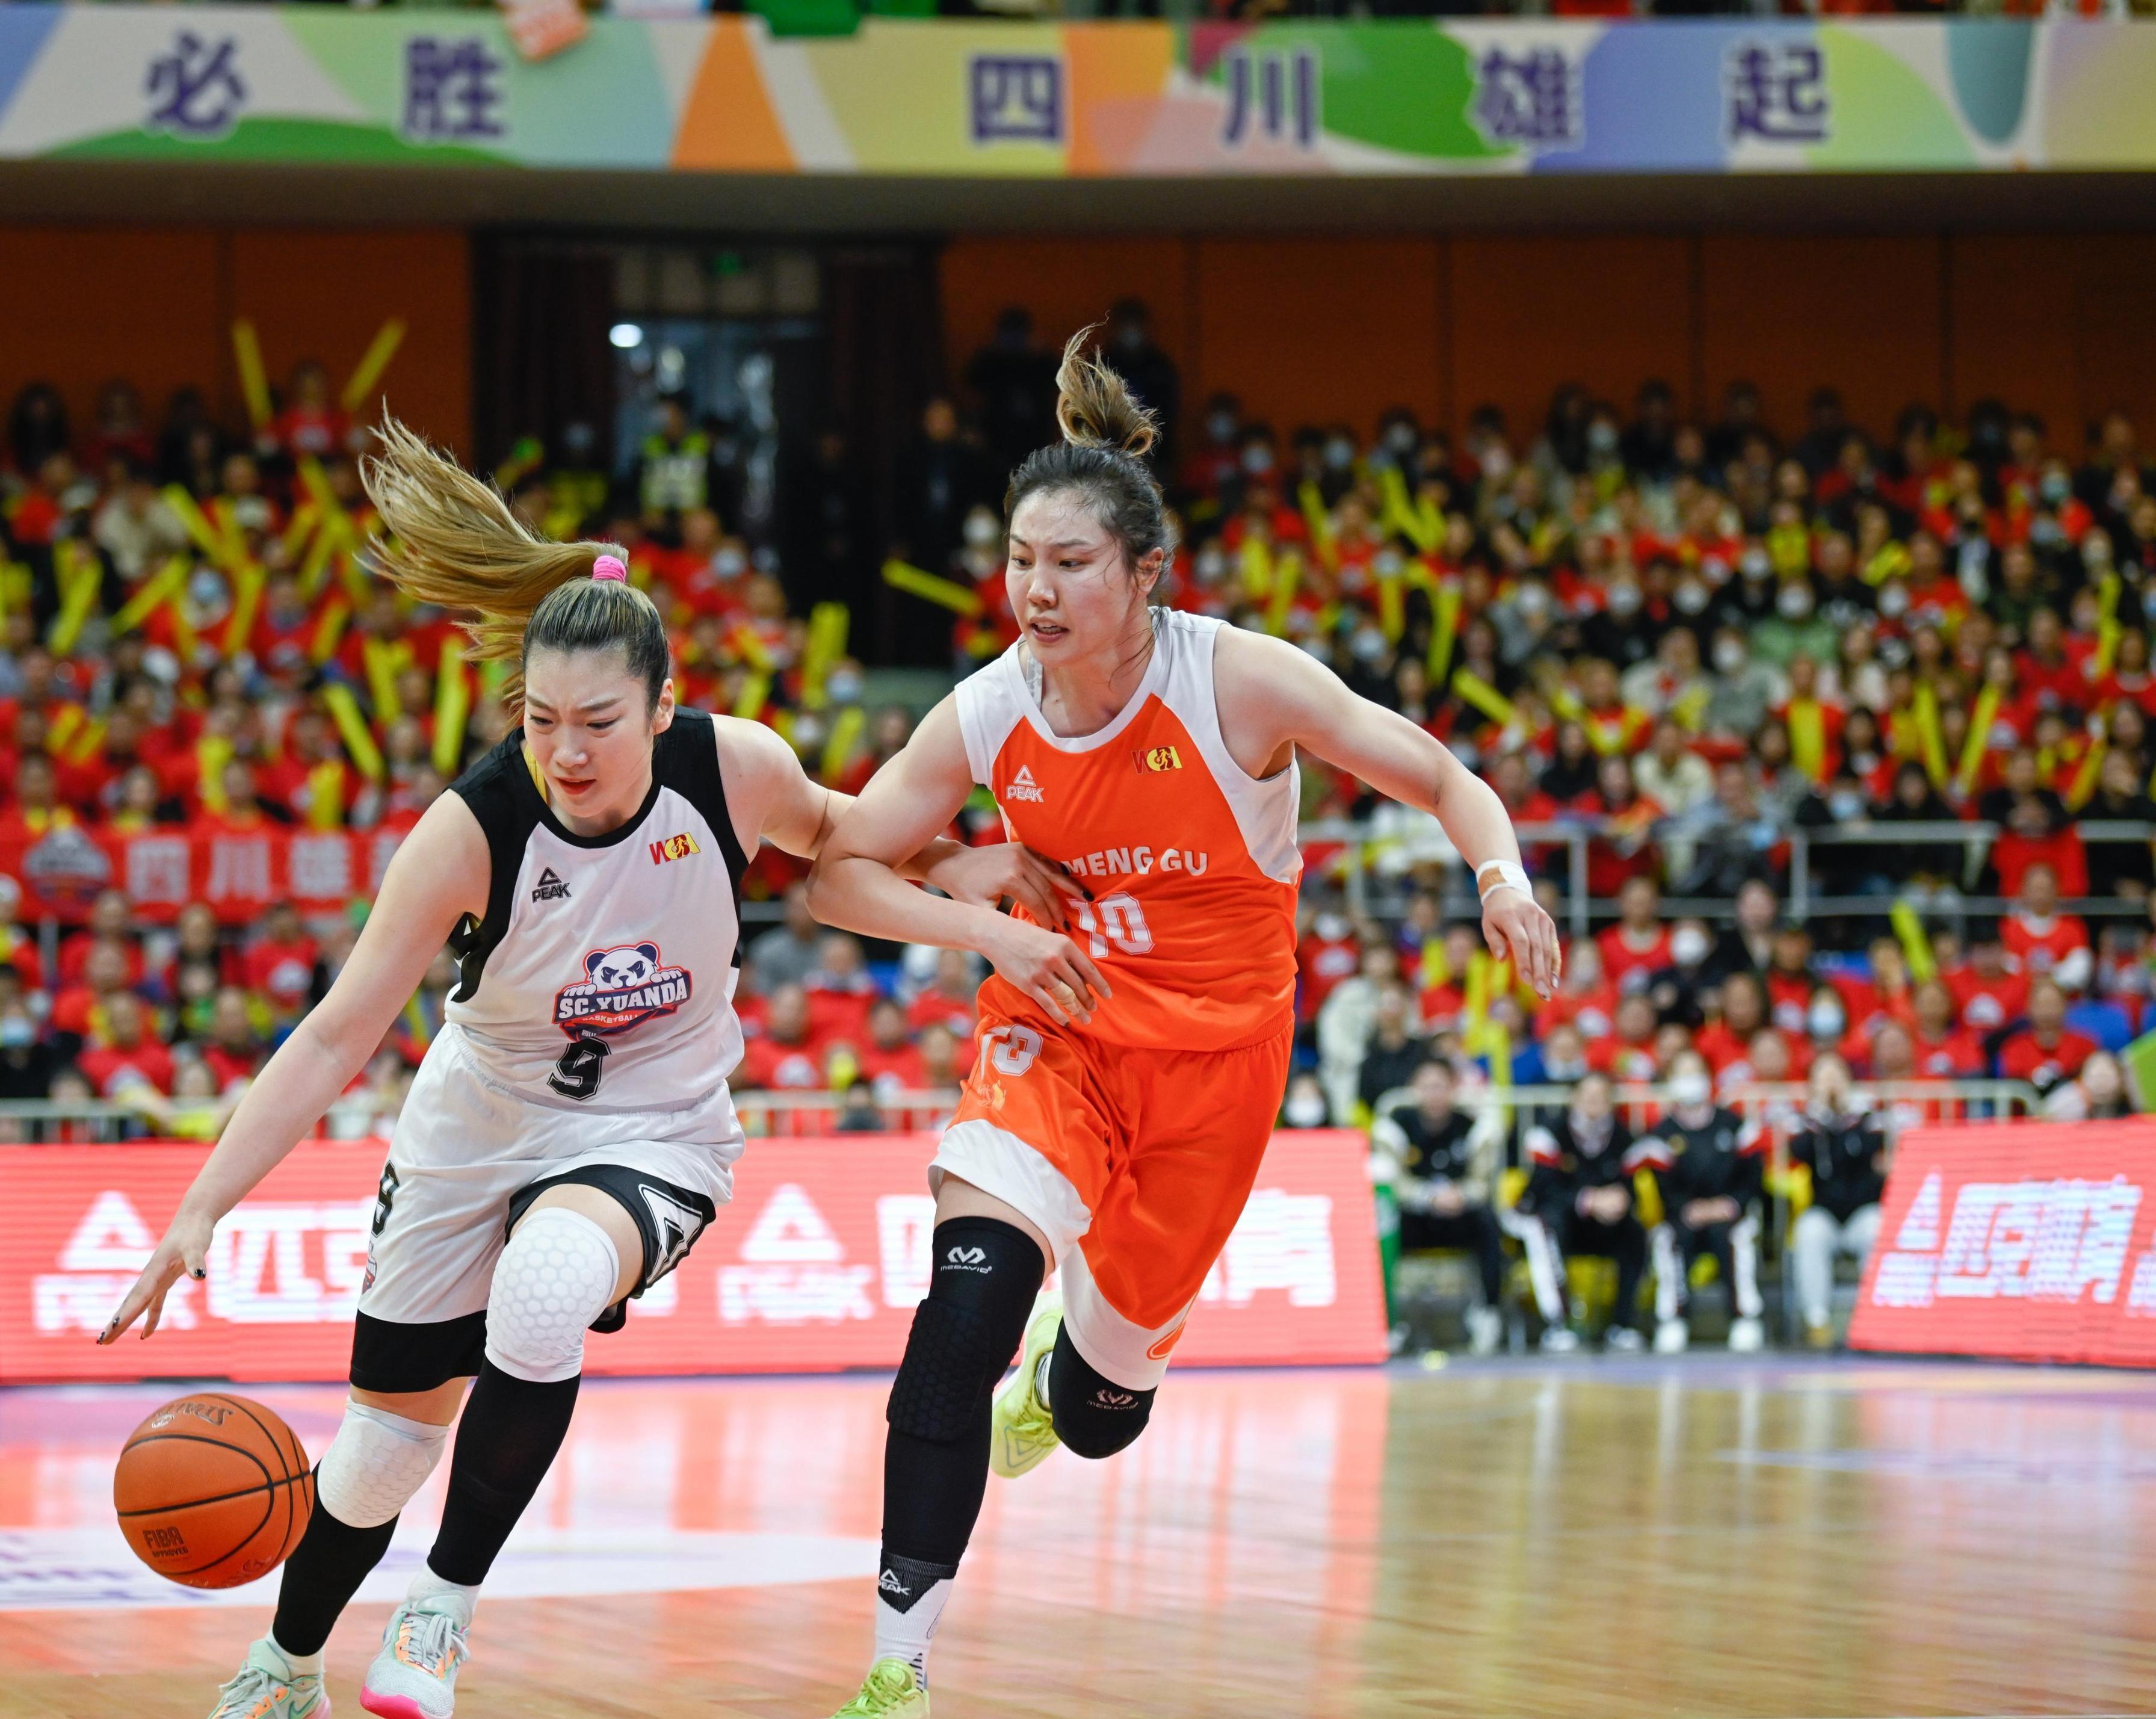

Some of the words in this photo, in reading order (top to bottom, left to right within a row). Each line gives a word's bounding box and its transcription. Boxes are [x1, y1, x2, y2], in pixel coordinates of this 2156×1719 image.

[1006, 785, 1045, 803] PEAK
[1160, 848, 1208, 876] GU
[532, 882, 572, 903] PEAK
[1066, 891, 1155, 958] 10
[546, 1036, 612, 1101] 9
[143, 1526, 184, 1549] FIBA
